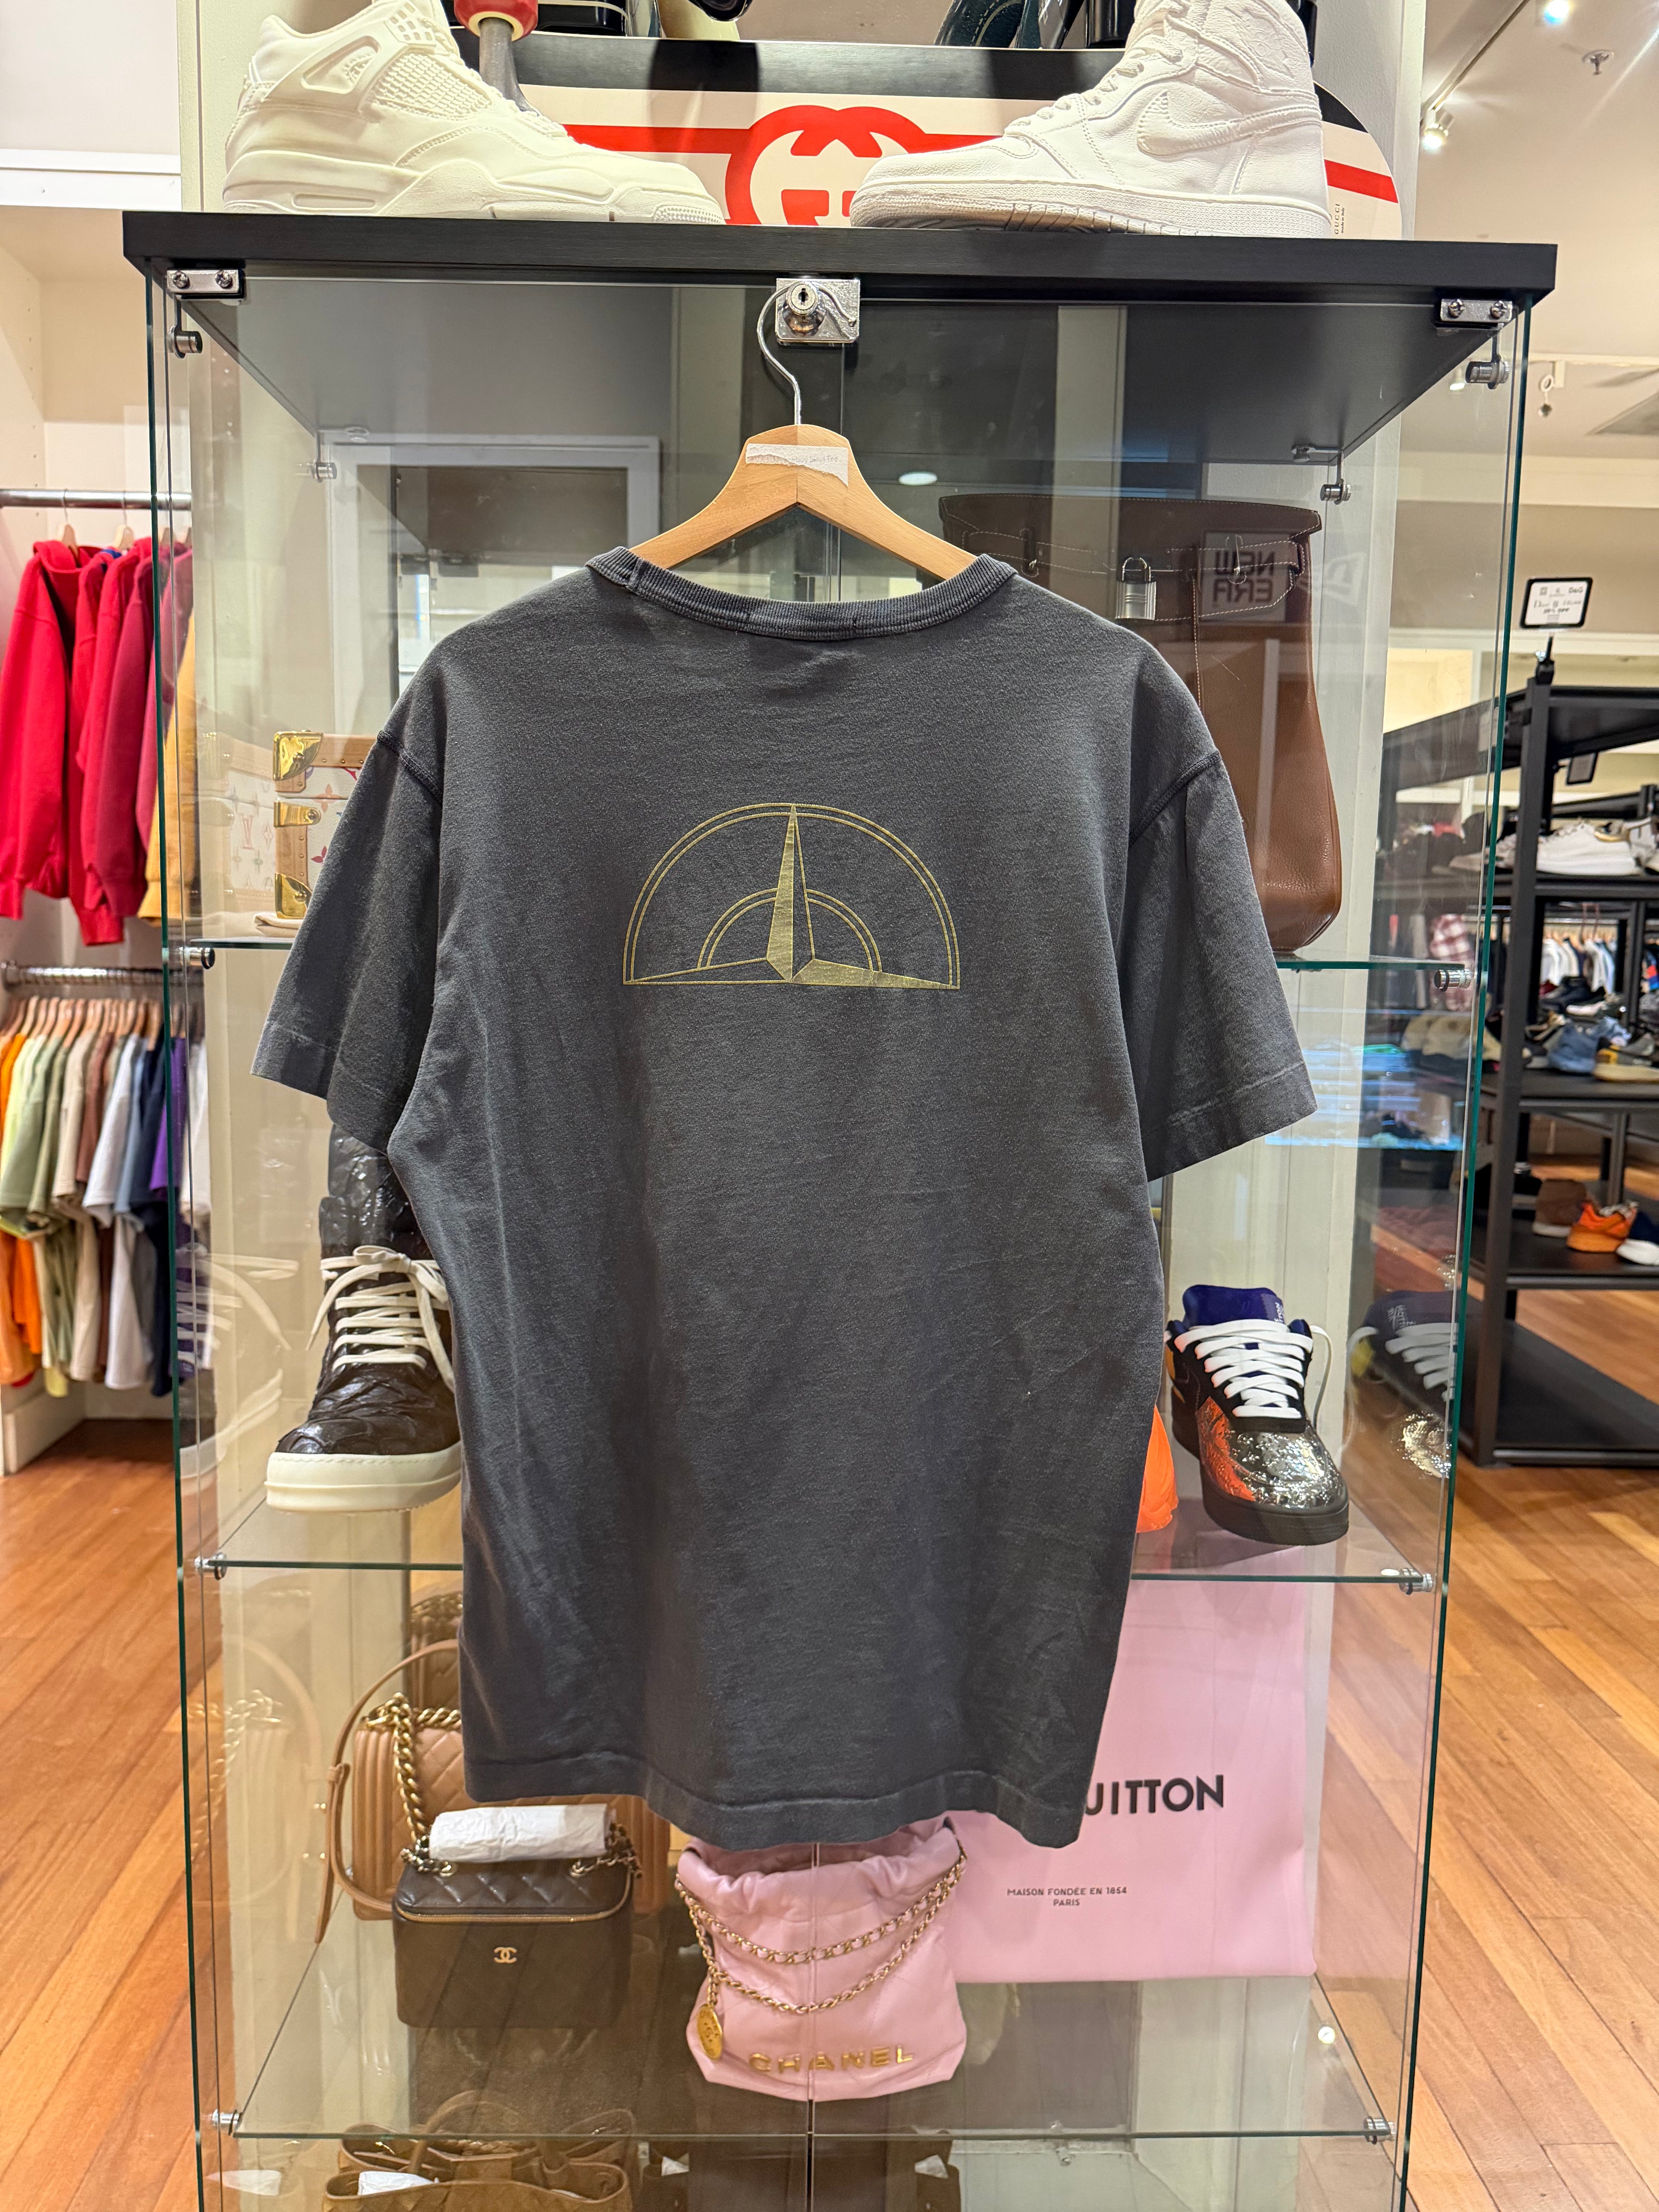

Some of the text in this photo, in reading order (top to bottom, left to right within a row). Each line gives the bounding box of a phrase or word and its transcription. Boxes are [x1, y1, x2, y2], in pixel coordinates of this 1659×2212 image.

[1007, 1888, 1045, 1896] MAISON
[1047, 1887, 1086, 1896] FONDÉE
[748, 2045, 913, 2073] CHANEL
